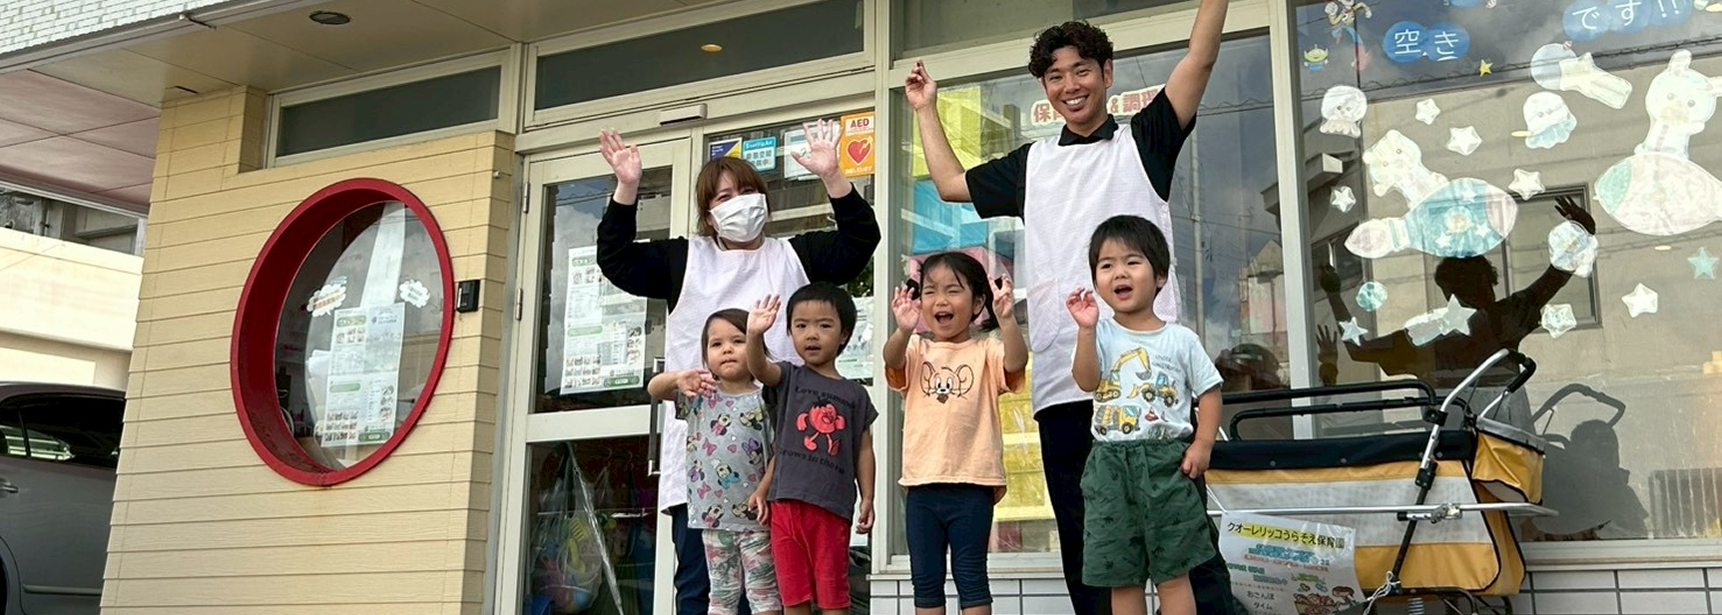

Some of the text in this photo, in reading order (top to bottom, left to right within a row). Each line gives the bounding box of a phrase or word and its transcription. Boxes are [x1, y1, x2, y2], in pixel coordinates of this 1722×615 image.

[1394, 28, 1459, 55] 空き
[850, 118, 870, 129] AED
[1227, 521, 1345, 549] クオーレリッコうらそえ保育園
